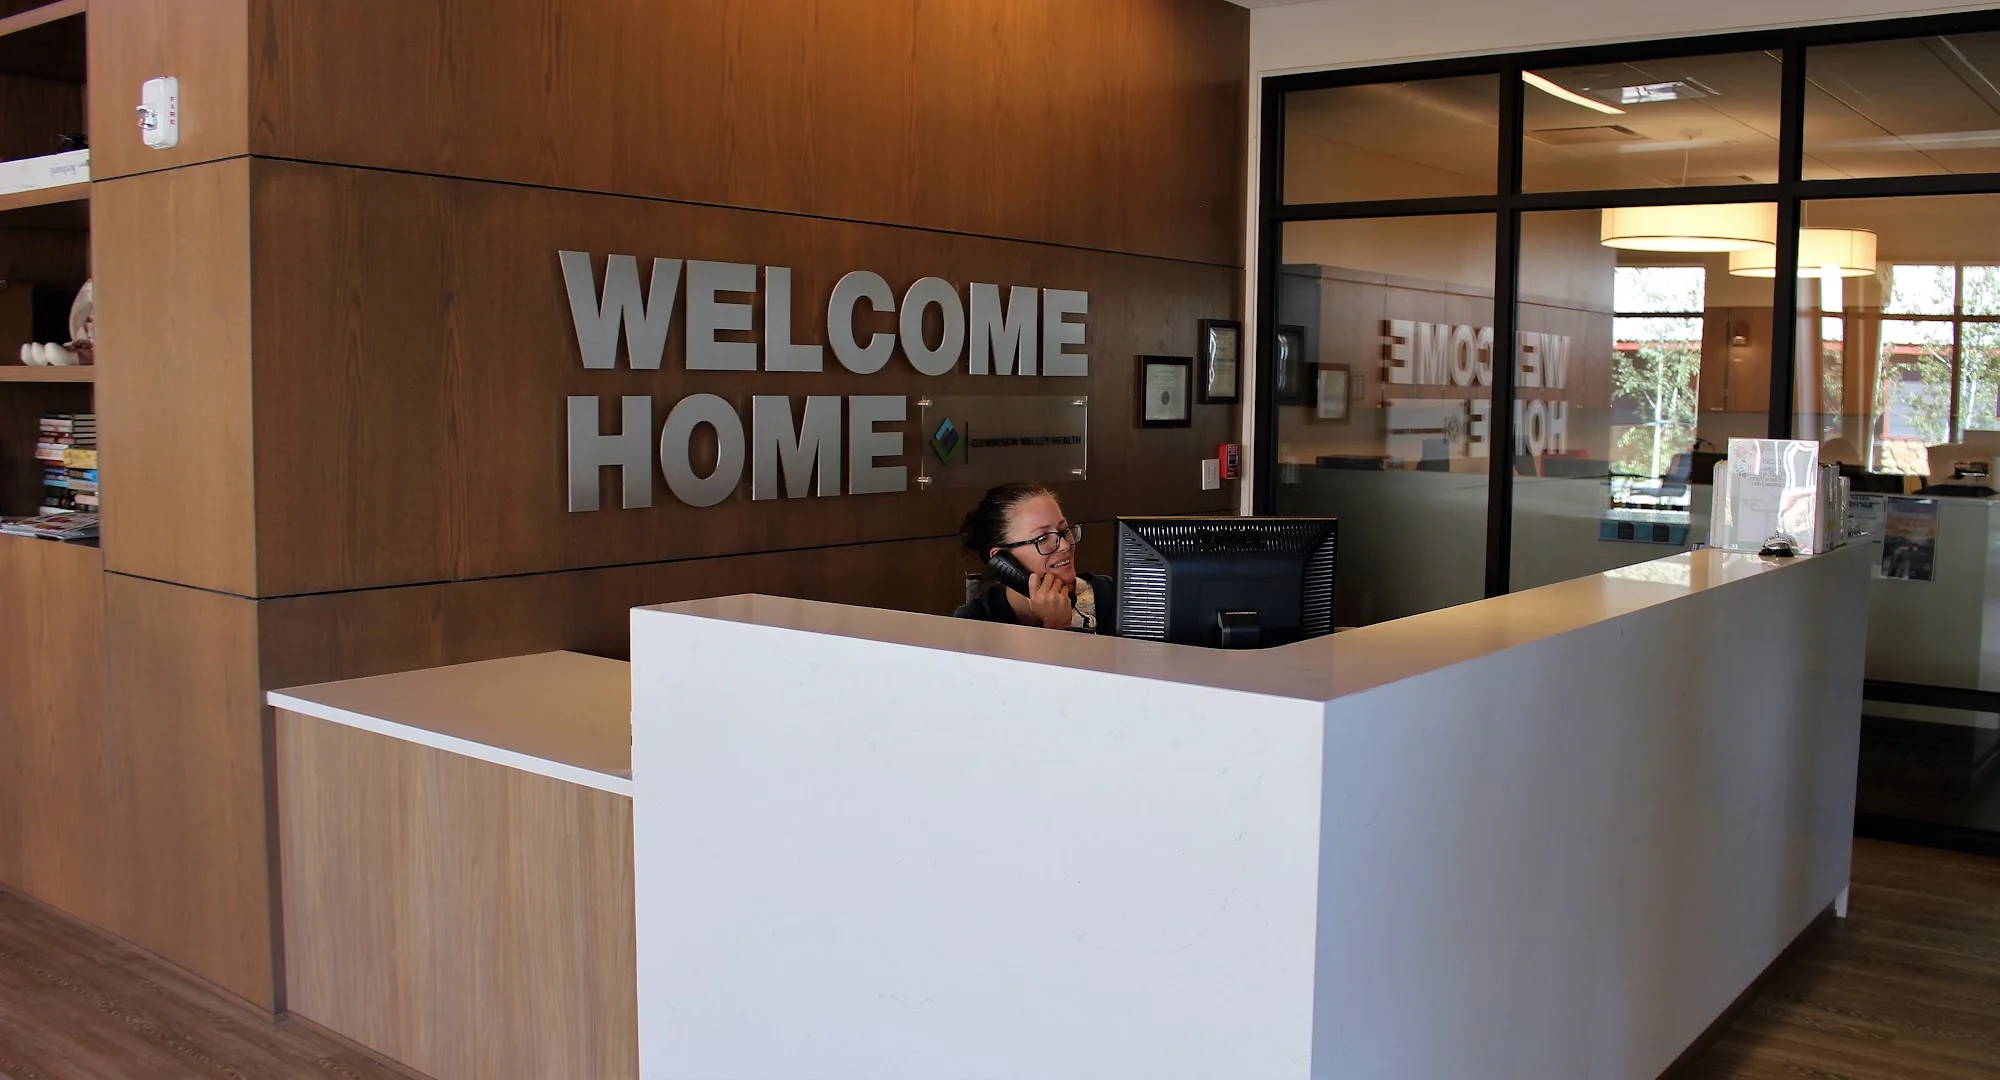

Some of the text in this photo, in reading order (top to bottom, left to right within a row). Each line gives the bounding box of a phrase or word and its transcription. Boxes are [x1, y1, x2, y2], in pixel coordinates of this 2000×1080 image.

[558, 250, 1088, 376] WELCOME
[567, 393, 907, 512] HOME
[1021, 436, 1050, 446] VALLEY
[1052, 435, 1082, 445] HEALTH
